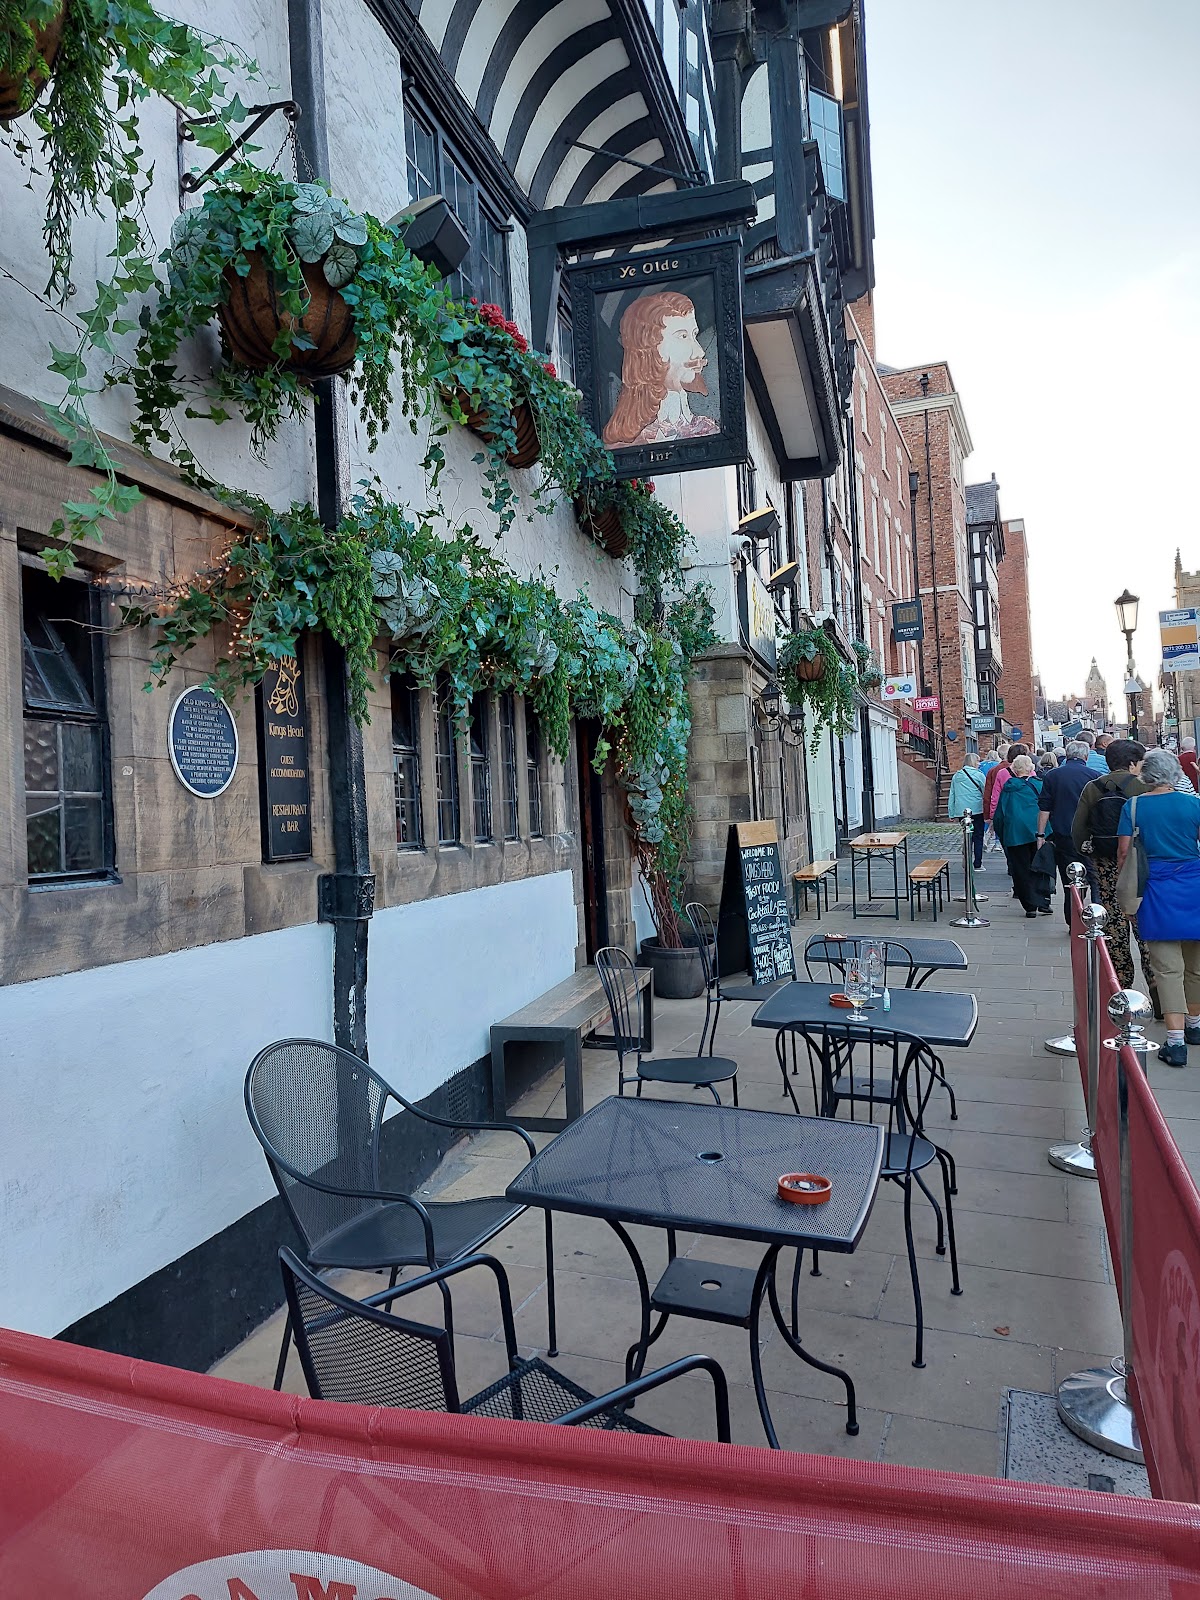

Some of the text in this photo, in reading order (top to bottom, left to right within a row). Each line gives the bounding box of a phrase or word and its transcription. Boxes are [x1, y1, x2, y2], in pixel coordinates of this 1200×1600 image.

[619, 259, 679, 278] Ye Olde
[183, 698, 194, 706] OLD
[211, 702, 224, 710] HEAD
[915, 701, 939, 710] HOME
[268, 722, 304, 740] Kings Head
[280, 755, 294, 765] GUEST
[271, 804, 307, 816] RESTAURANT
[280, 820, 300, 833] & BAR
[740, 847, 766, 860] WELCOME
[766, 846, 774, 856] TO
[761, 880, 780, 895] FOOD!
[747, 899, 779, 921] Cocktails
